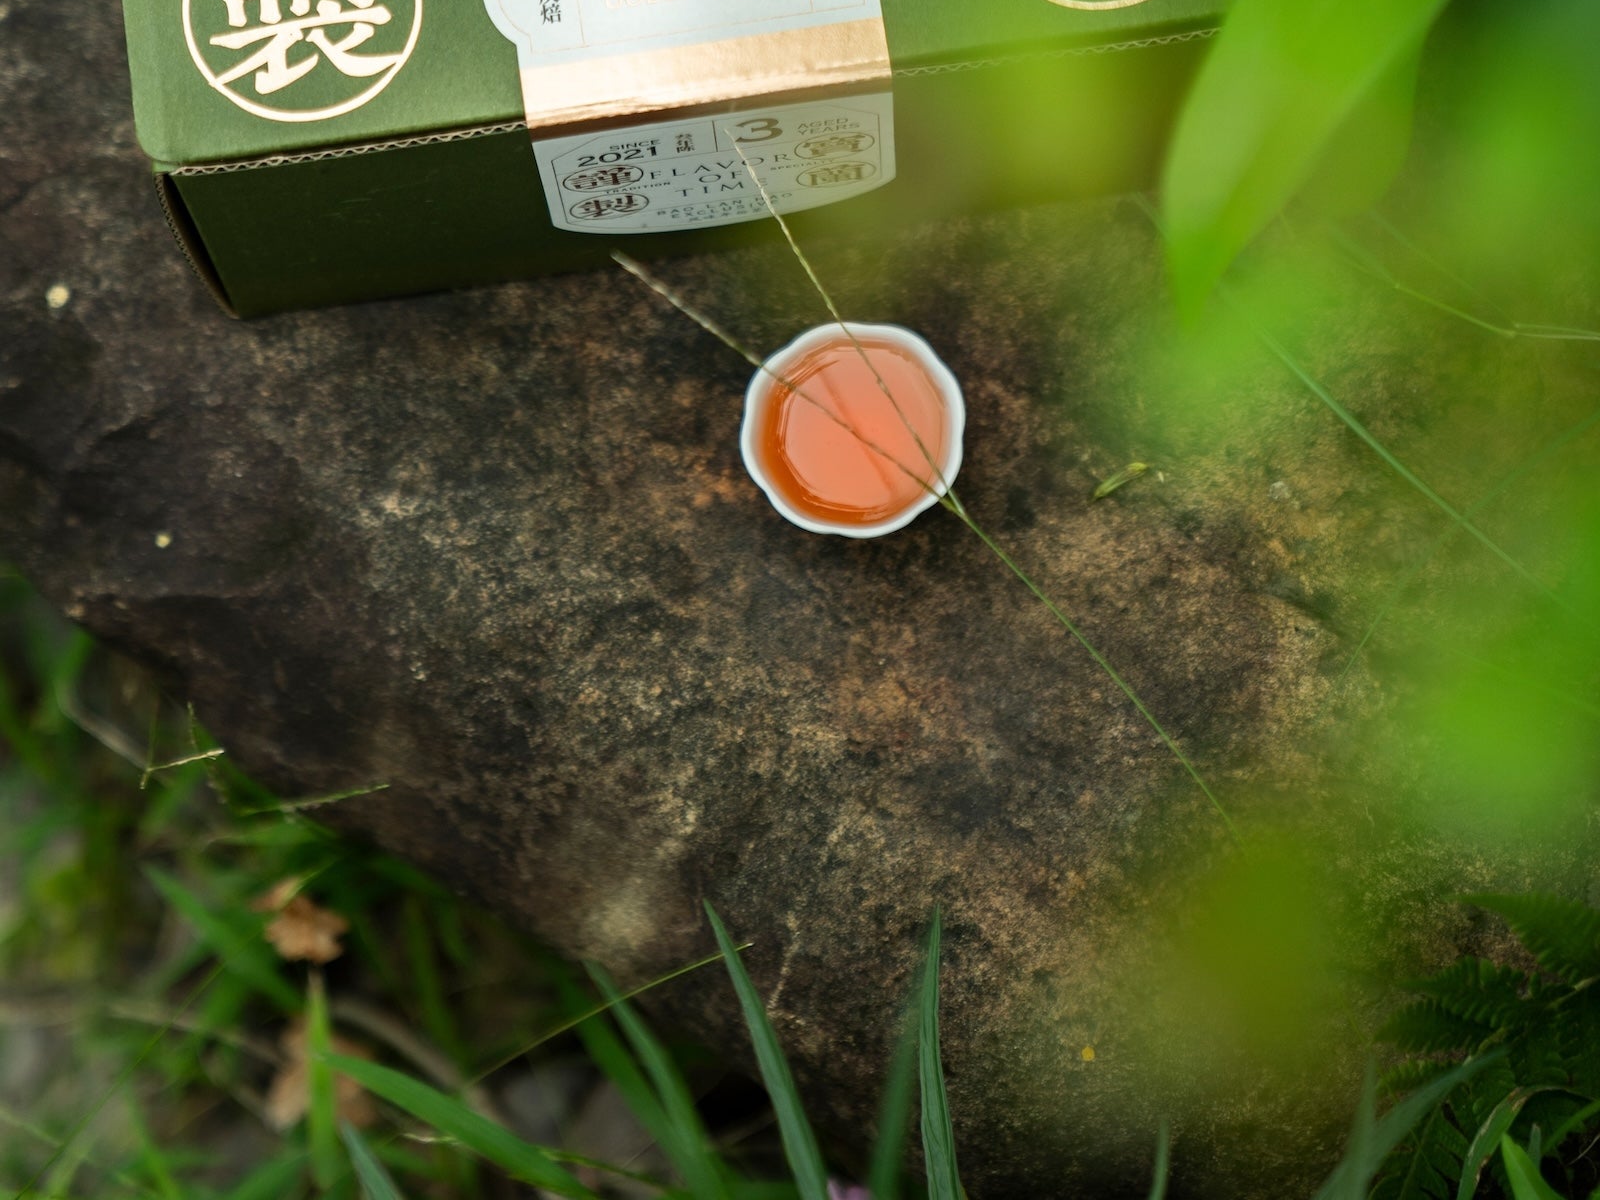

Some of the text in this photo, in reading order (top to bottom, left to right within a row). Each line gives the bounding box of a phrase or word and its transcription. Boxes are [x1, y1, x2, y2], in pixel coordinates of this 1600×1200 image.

[736, 118, 783, 142] 3
[798, 118, 848, 130] AGED
[798, 123, 860, 136] YEARS
[609, 139, 661, 151] SINCE
[578, 146, 658, 167] 2021
[651, 153, 792, 180] FLAVOR
[699, 170, 743, 183] OF
[605, 181, 671, 195] TRADITION
